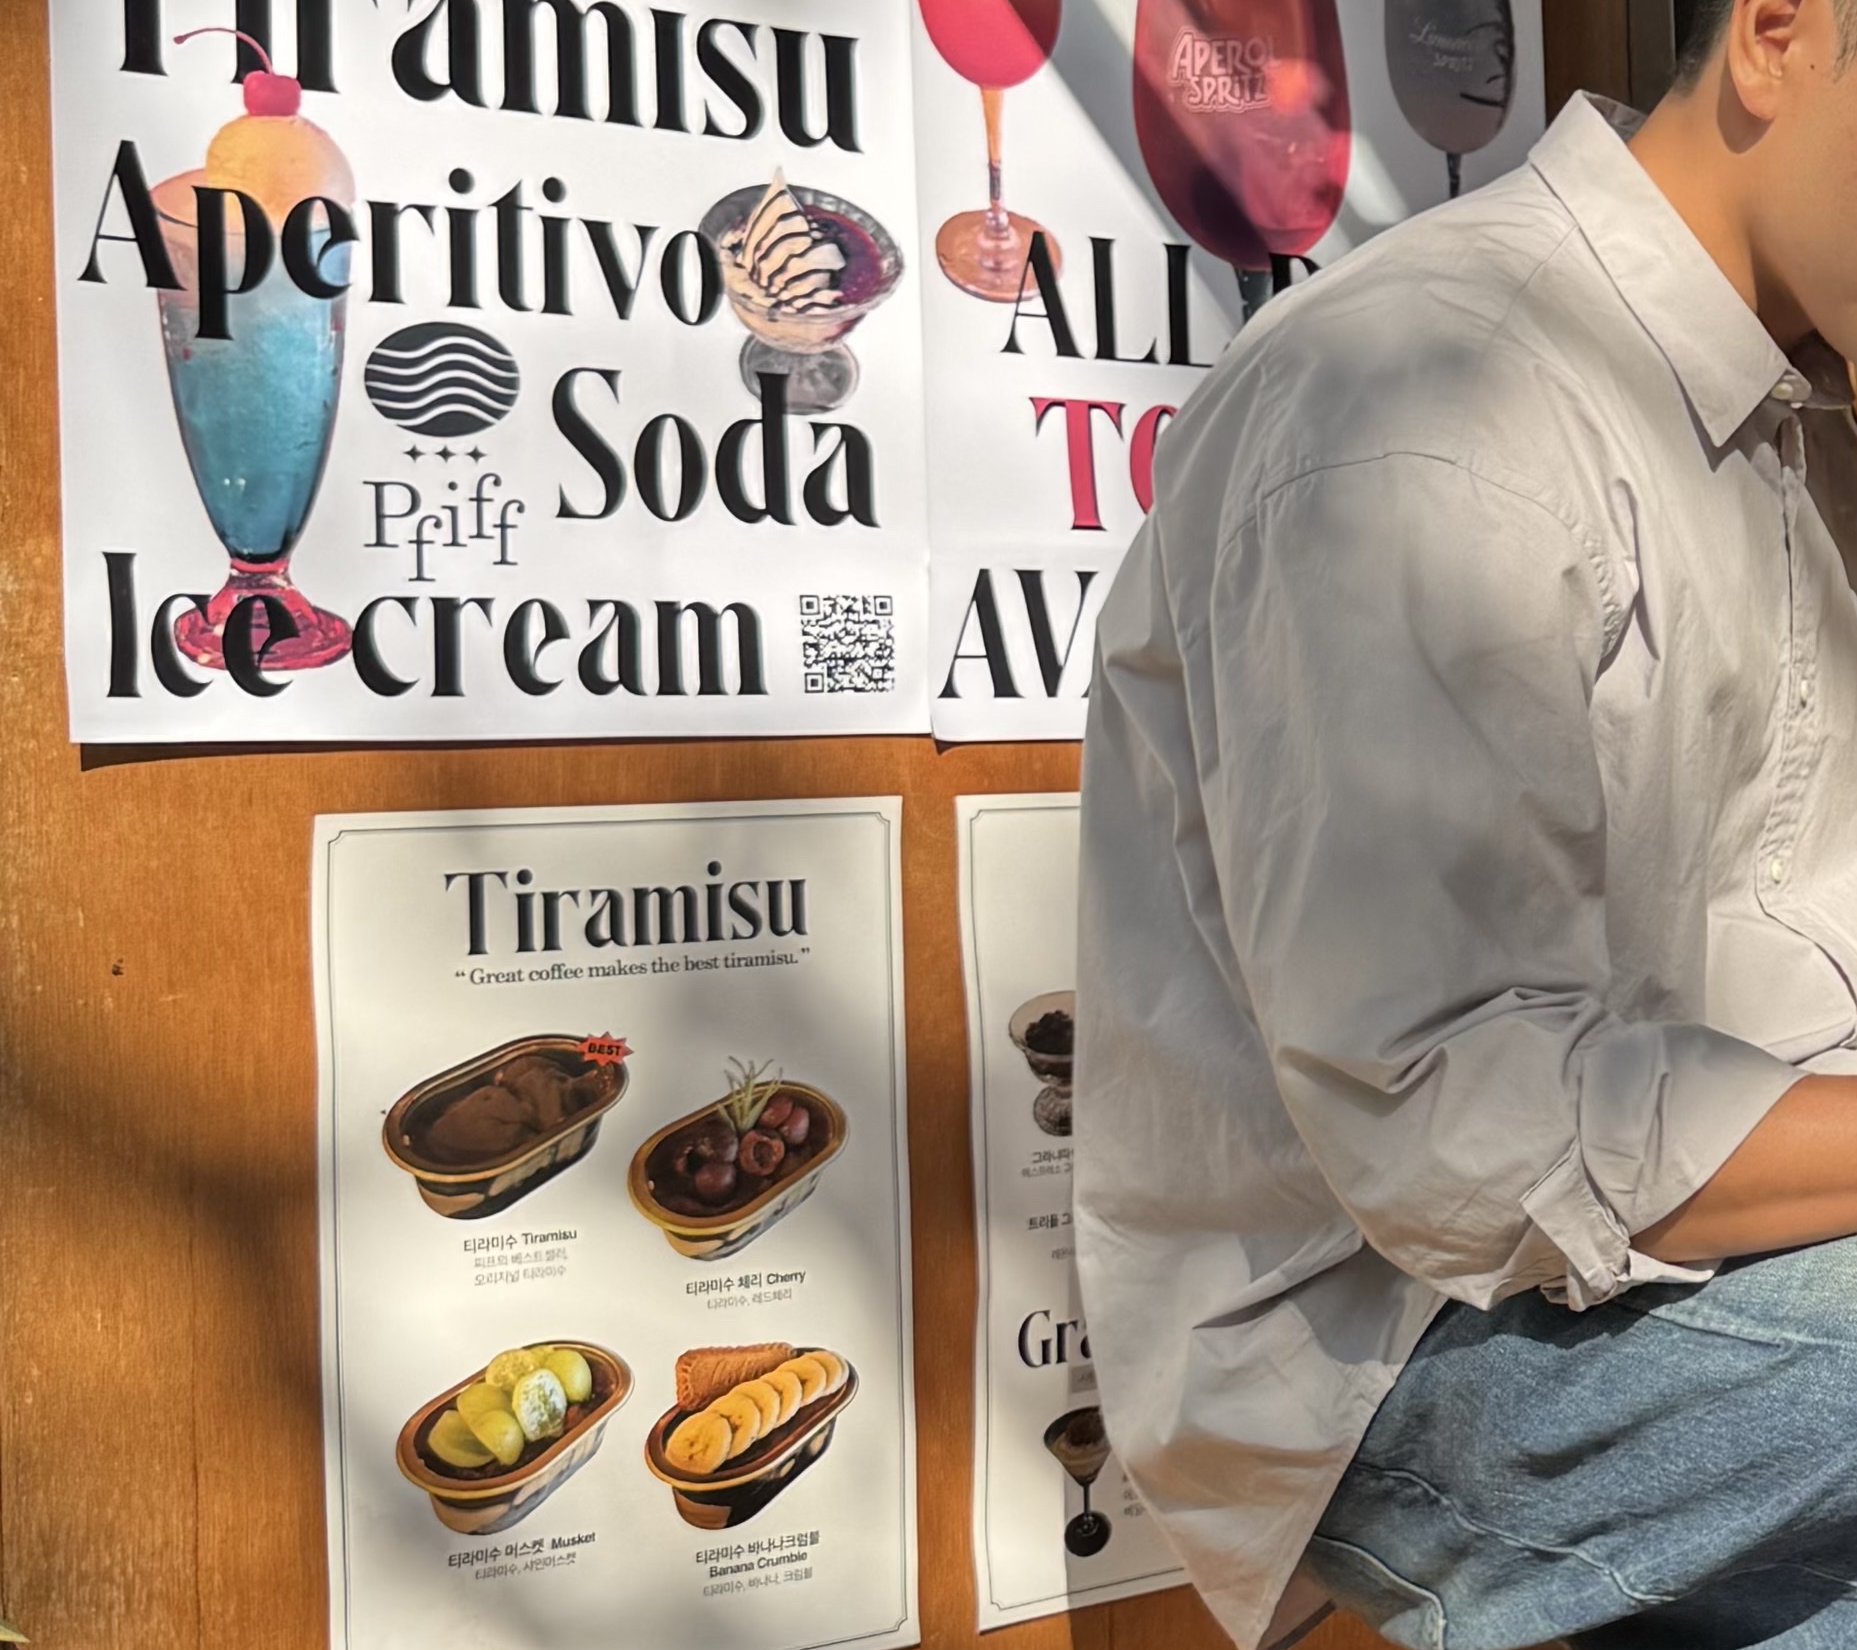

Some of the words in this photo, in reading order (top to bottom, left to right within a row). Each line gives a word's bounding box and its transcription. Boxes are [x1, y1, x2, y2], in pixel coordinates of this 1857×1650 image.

[78, 139, 725, 340] Aperitivo
[1000, 230, 1230, 368] ALL
[552, 367, 882, 529] Soda
[362, 472, 525, 582] Pfiff
[102, 551, 302, 699] Ice
[352, 594, 769, 699] cream
[445, 860, 809, 956] Tiramisu
[528, 963, 585, 982] coffee
[588, 960, 648, 979] makes
[651, 958, 680, 975] the
[684, 954, 721, 971] best
[587, 1041, 622, 1057] BEST
[463, 1234, 518, 1254] 티라미수
[521, 1229, 578, 1246] Tiramisu
[686, 1276, 735, 1297] 티라미수
[766, 1270, 806, 1285] Cherry
[447, 1545, 502, 1569] 티라미수
[550, 1531, 596, 1551] Musket
[695, 1544, 746, 1565] 티라미수
[709, 1561, 755, 1579] Banana
[757, 1550, 808, 1570] Crumble
